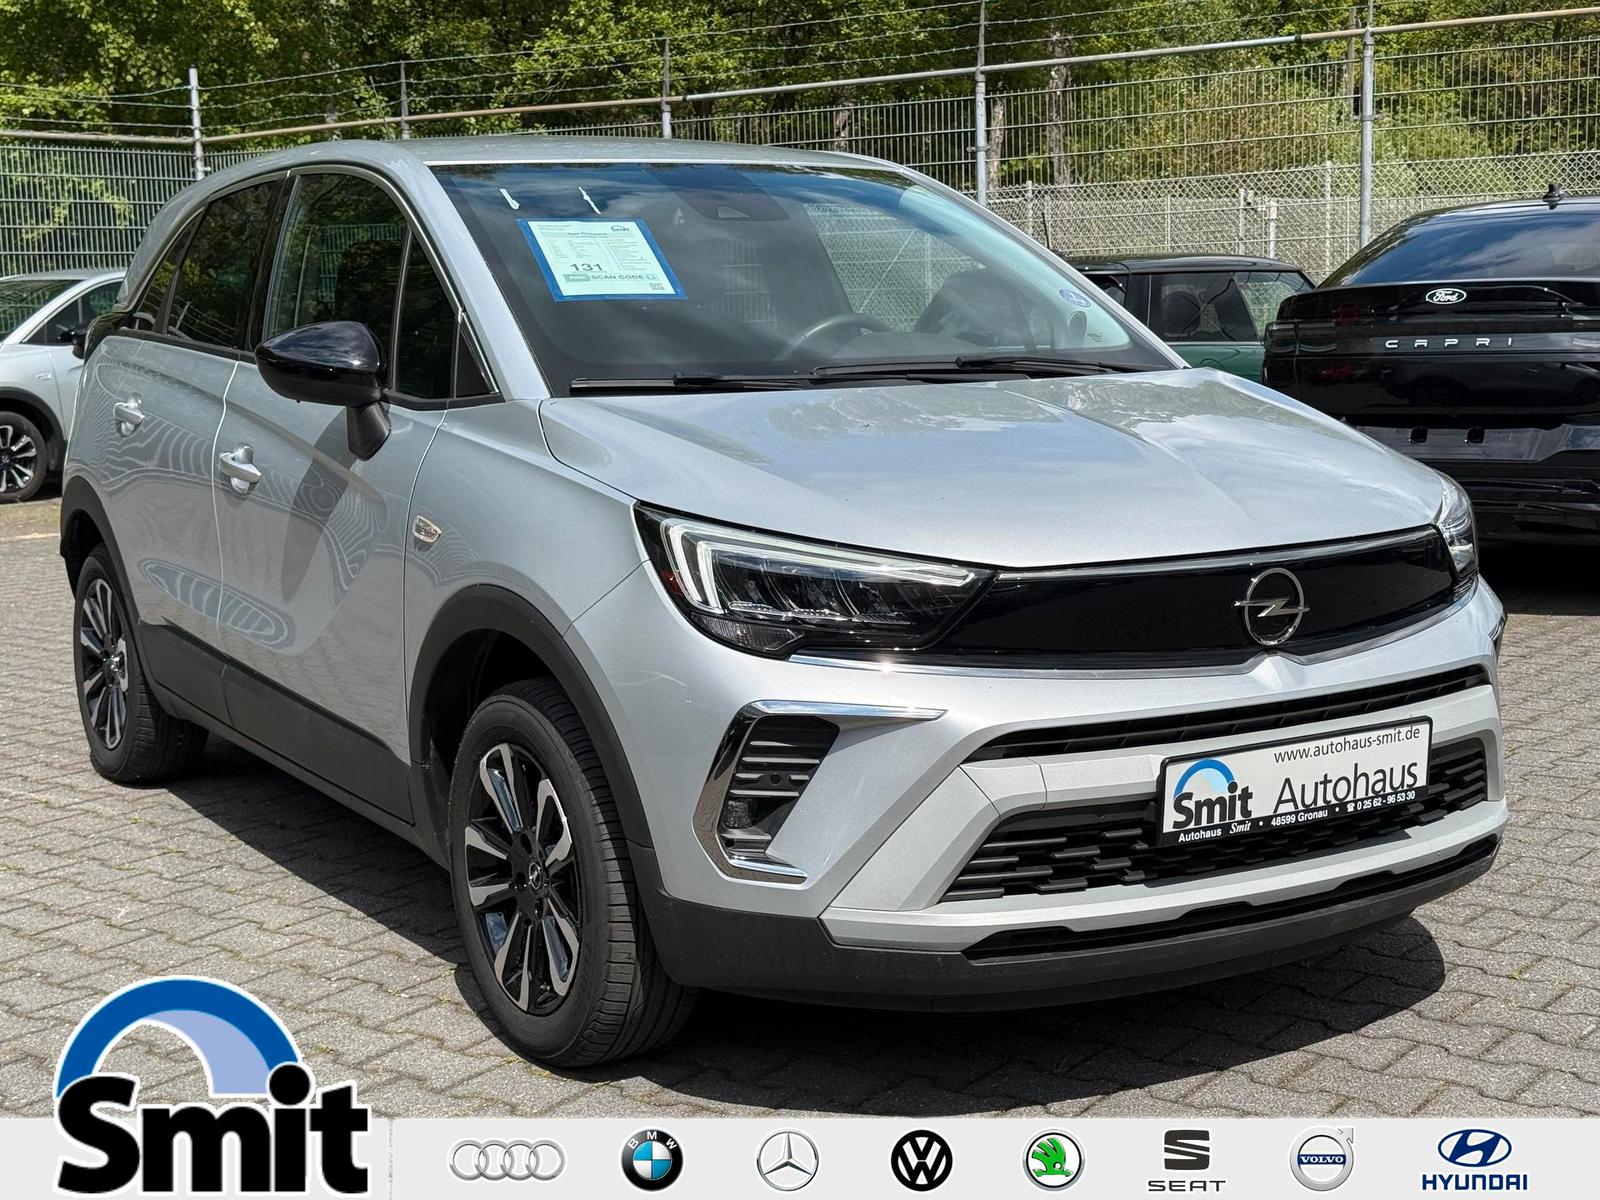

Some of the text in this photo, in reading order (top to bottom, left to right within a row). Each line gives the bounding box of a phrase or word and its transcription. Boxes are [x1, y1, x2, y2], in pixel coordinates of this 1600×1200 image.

[570, 263, 603, 271] 131
[1433, 290, 1458, 301] Ford
[1385, 338, 1512, 348] CAPRI
[1274, 725, 1420, 763] www.autohaus-smit.de
[1273, 762, 1418, 814] Autohaus
[1172, 782, 1253, 829] Smit
[1178, 828, 1222, 842] Autohaus
[1229, 821, 1251, 834] Smit
[1271, 814, 1296, 826] 48599
[1297, 808, 1328, 822] Gronau
